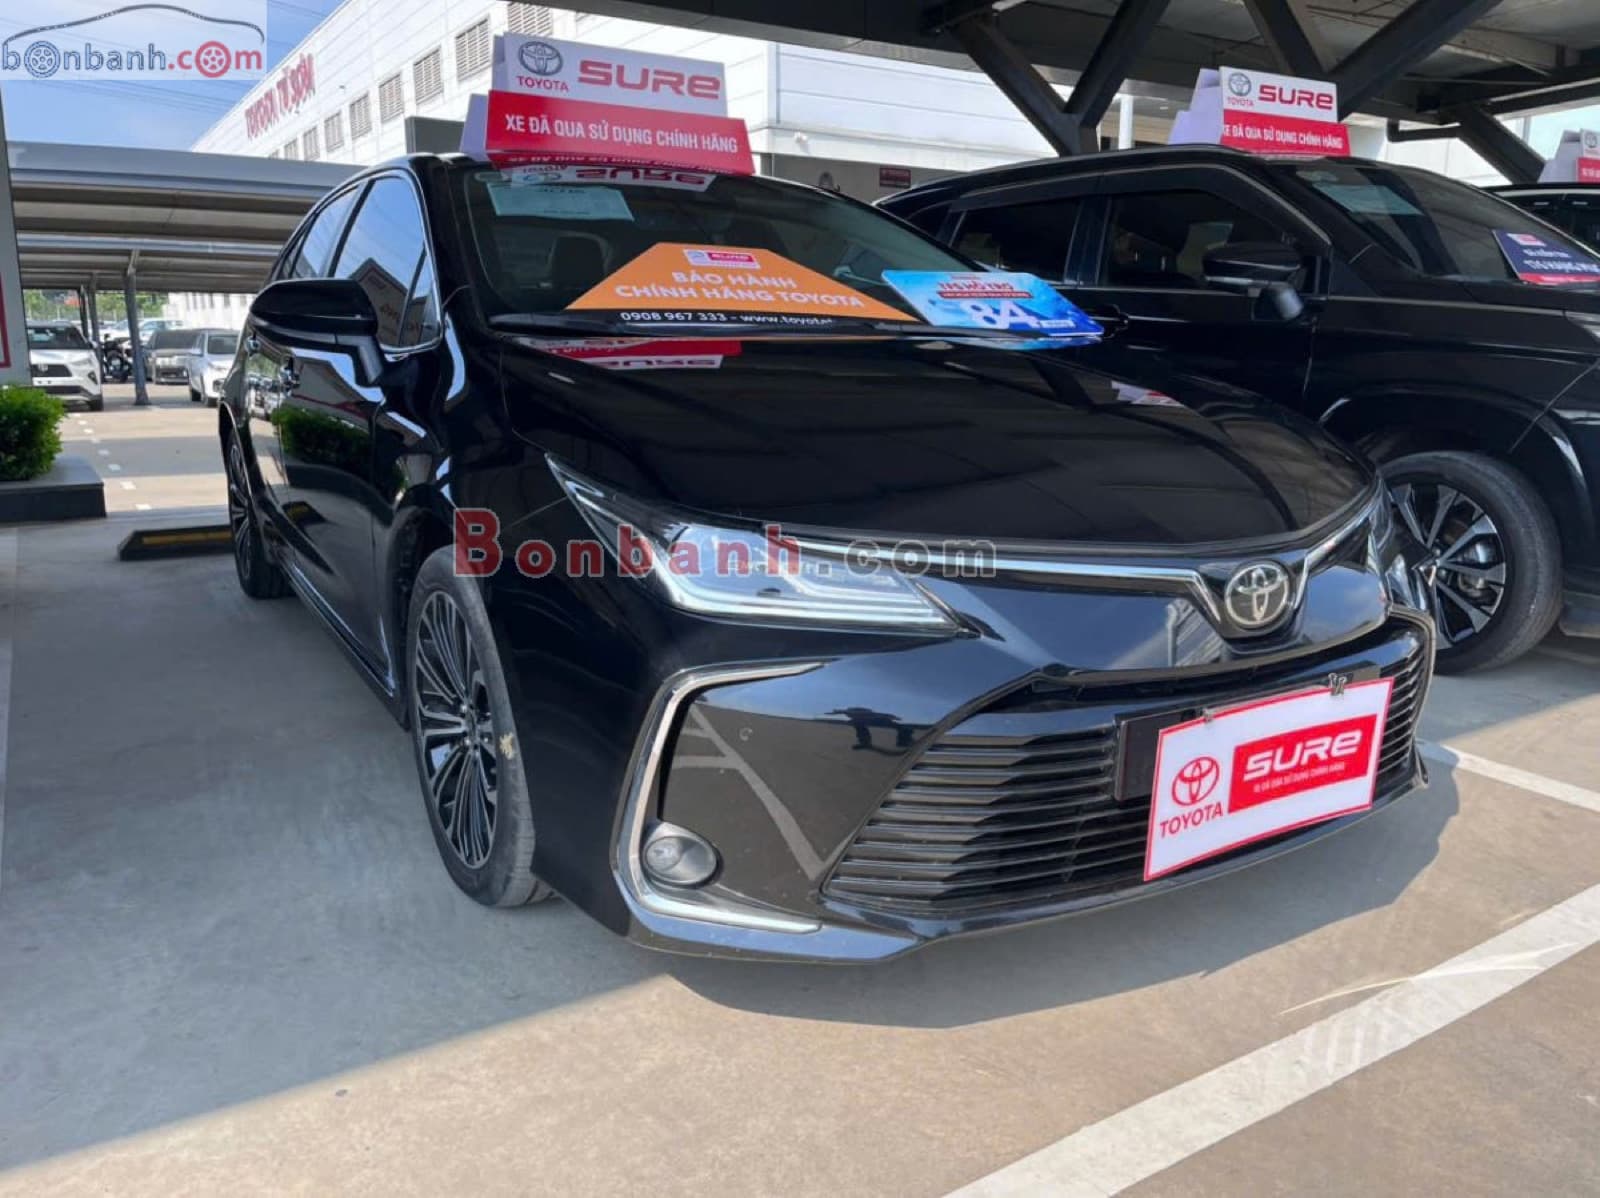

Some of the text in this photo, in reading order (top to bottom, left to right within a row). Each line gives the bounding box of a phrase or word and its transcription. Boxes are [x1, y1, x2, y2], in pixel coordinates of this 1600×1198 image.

[516, 75, 569, 93] TOYOTA
[1227, 97, 1254, 107] TOYOTA
[505, 114, 525, 133] XE
[529, 115, 551, 135] ĐÃ
[554, 119, 585, 139] QUA
[588, 119, 608, 141] SỬ
[613, 127, 652, 146] DỤNG
[656, 129, 698, 149] CHÍNH
[615, 283, 698, 298] CHÍNH
[776, 291, 864, 307] TOYOTA
[620, 311, 662, 321] 0908
[664, 312, 693, 321] 967
[697, 312, 727, 322] 333
[1159, 802, 1224, 839] TOYOTA
